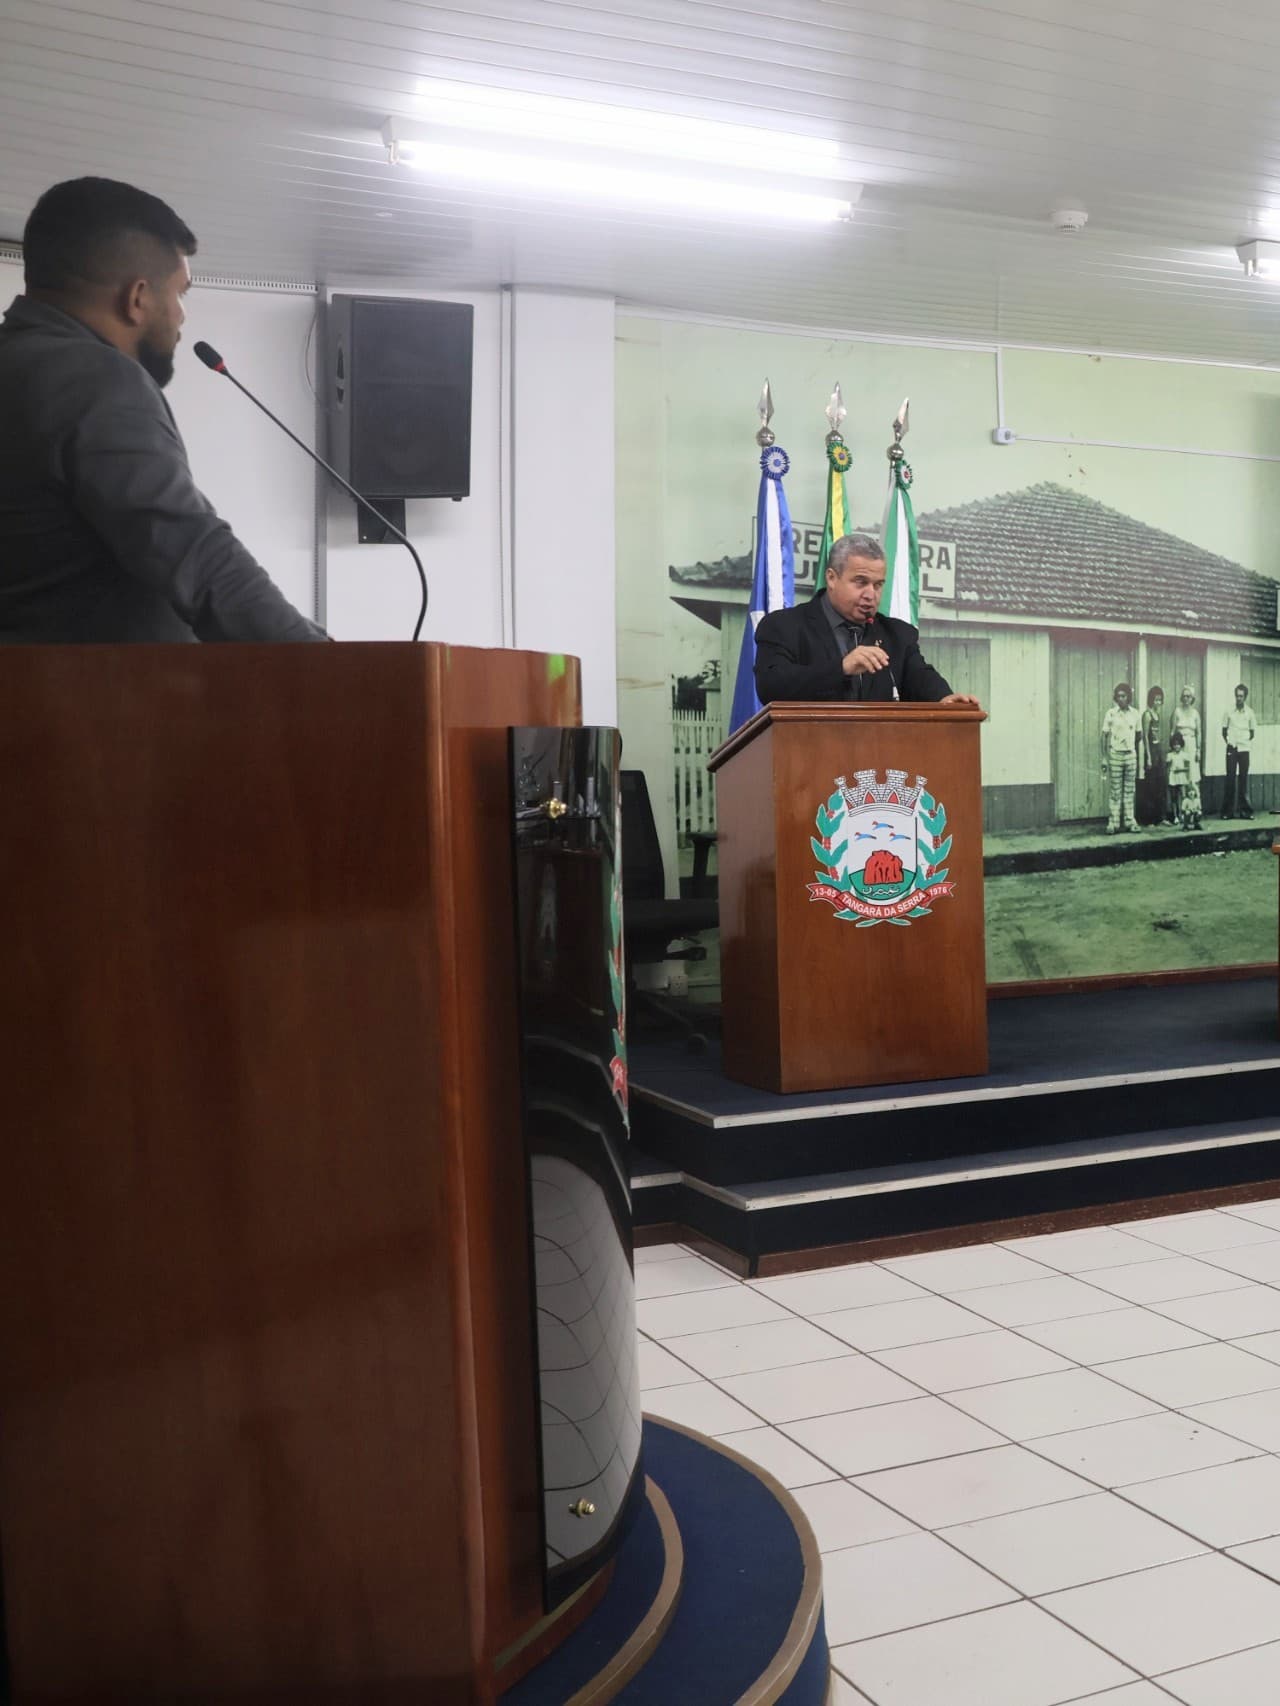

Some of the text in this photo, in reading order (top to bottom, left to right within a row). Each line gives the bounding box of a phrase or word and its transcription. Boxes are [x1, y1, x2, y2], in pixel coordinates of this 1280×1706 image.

[928, 886, 948, 897] 1976
[841, 892, 926, 917] TANGARÁ DA SERRA
